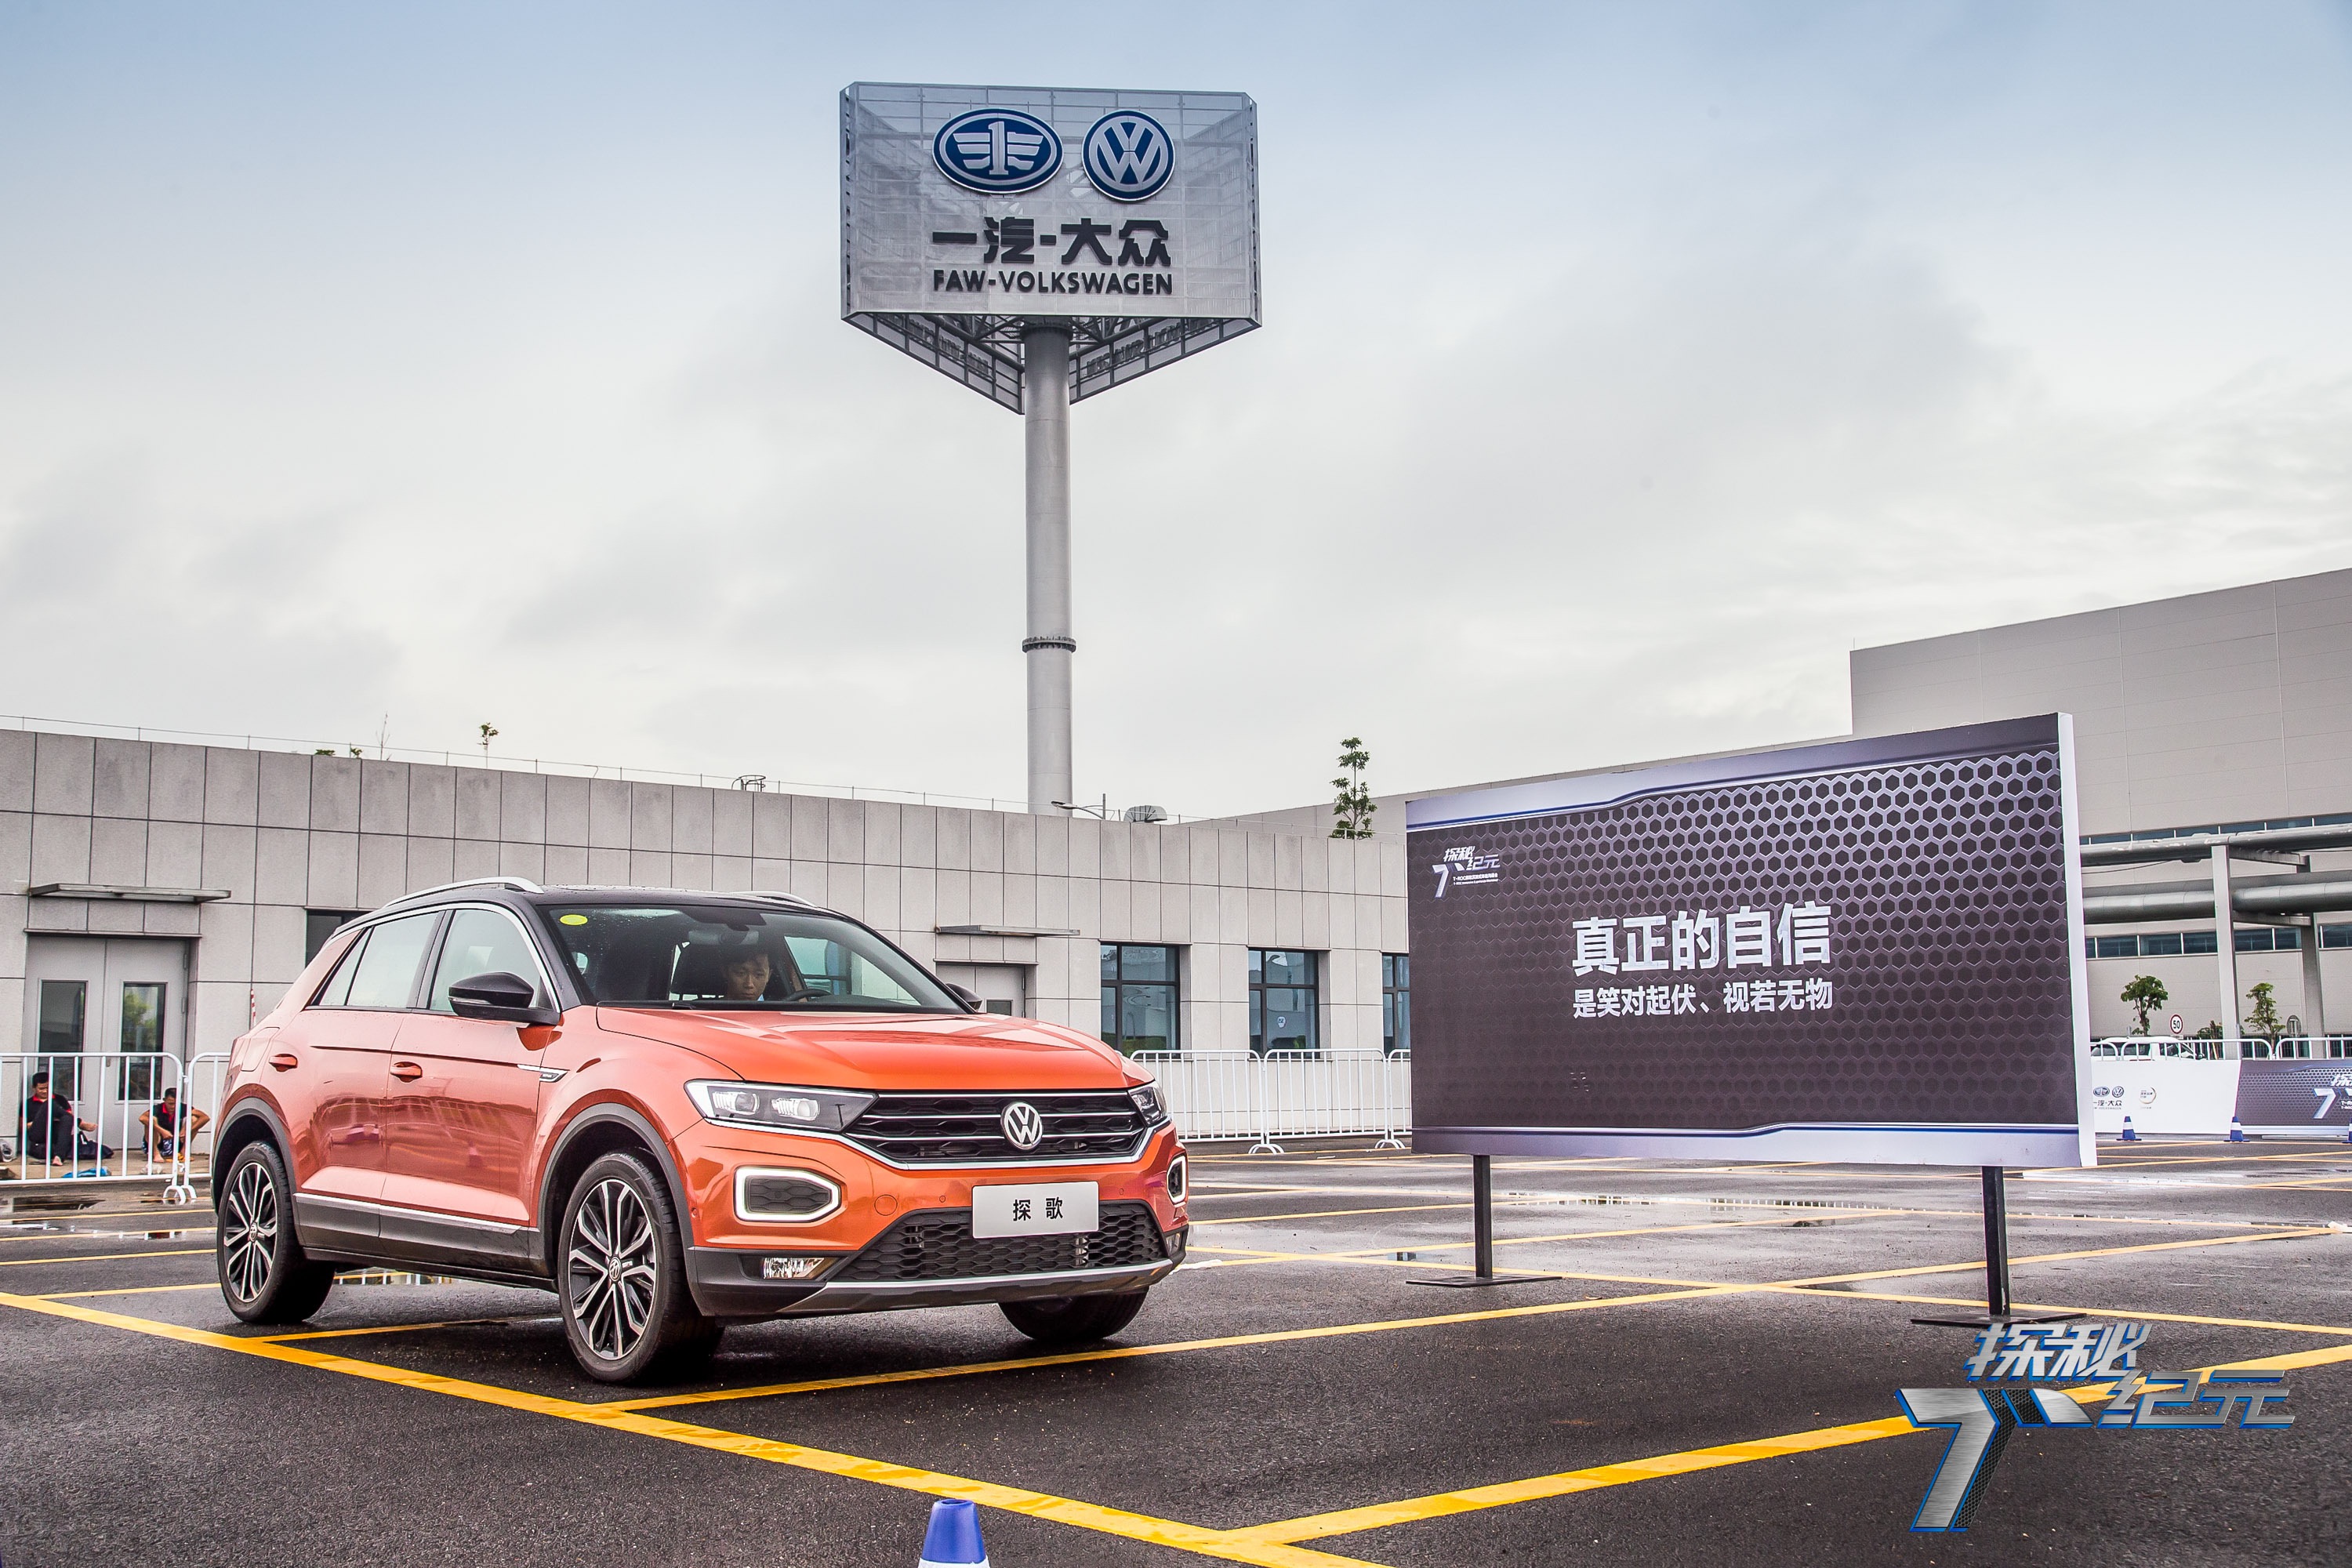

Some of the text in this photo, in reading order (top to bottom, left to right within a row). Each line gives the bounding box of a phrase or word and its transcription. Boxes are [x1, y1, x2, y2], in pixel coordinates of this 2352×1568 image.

[932, 216, 1171, 267] 一汽-大众
[933, 269, 1173, 295] FAW-VOLKSWAGEN
[1572, 900, 1831, 977] 真正的自信
[1573, 977, 1833, 1018] 是笑对起伏、视若无物
[2172, 1020, 2180, 1029] 50
[1013, 1196, 1063, 1221] 探歌
